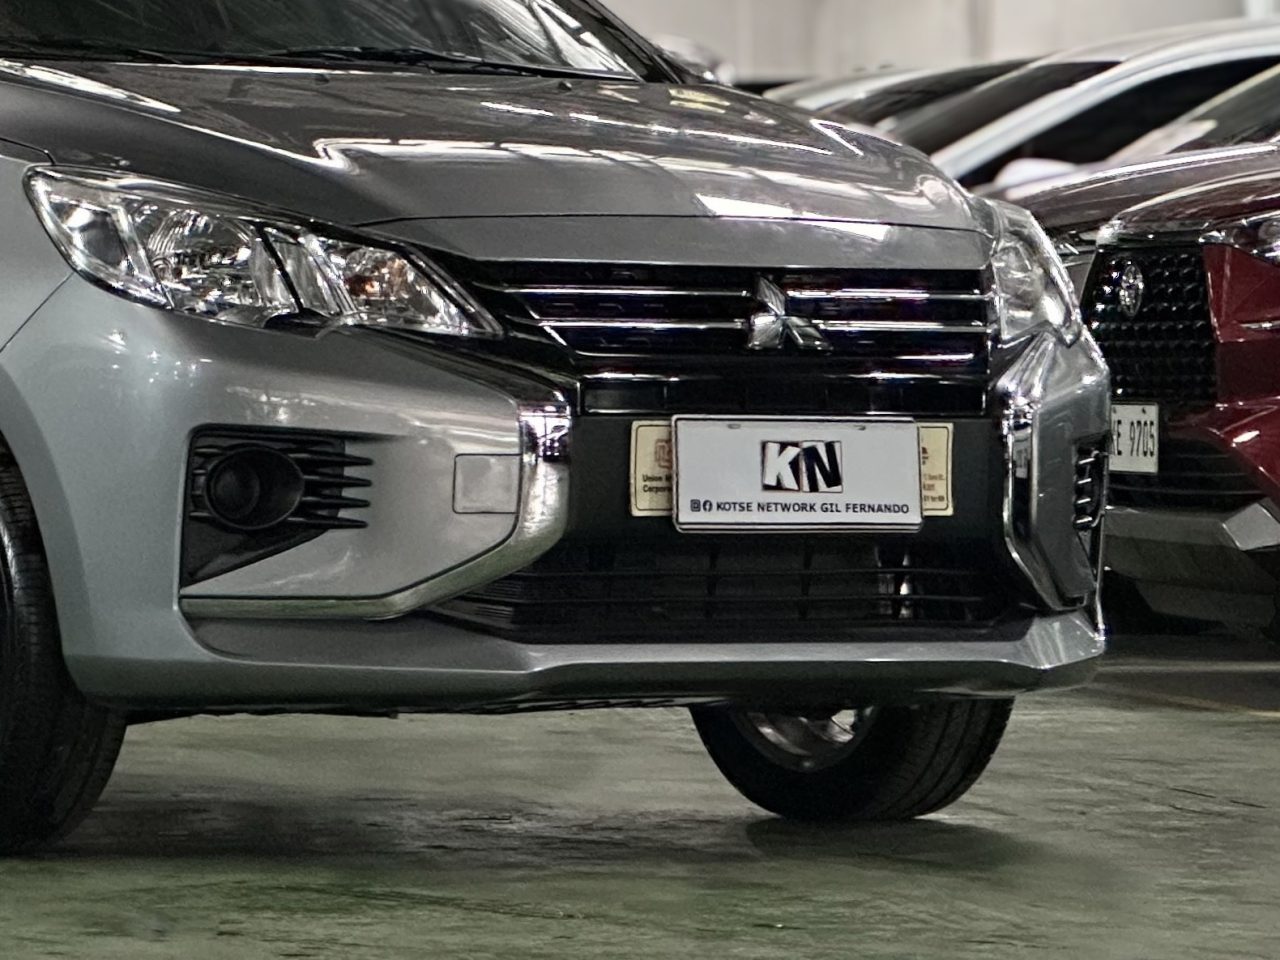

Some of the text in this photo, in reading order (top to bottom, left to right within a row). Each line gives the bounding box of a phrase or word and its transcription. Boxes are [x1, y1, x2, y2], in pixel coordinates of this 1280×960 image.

[1130, 420, 1155, 457] 9705
[762, 441, 842, 492] KN
[716, 502, 910, 514] KOTSE NETWORK GIL FERNANDO
